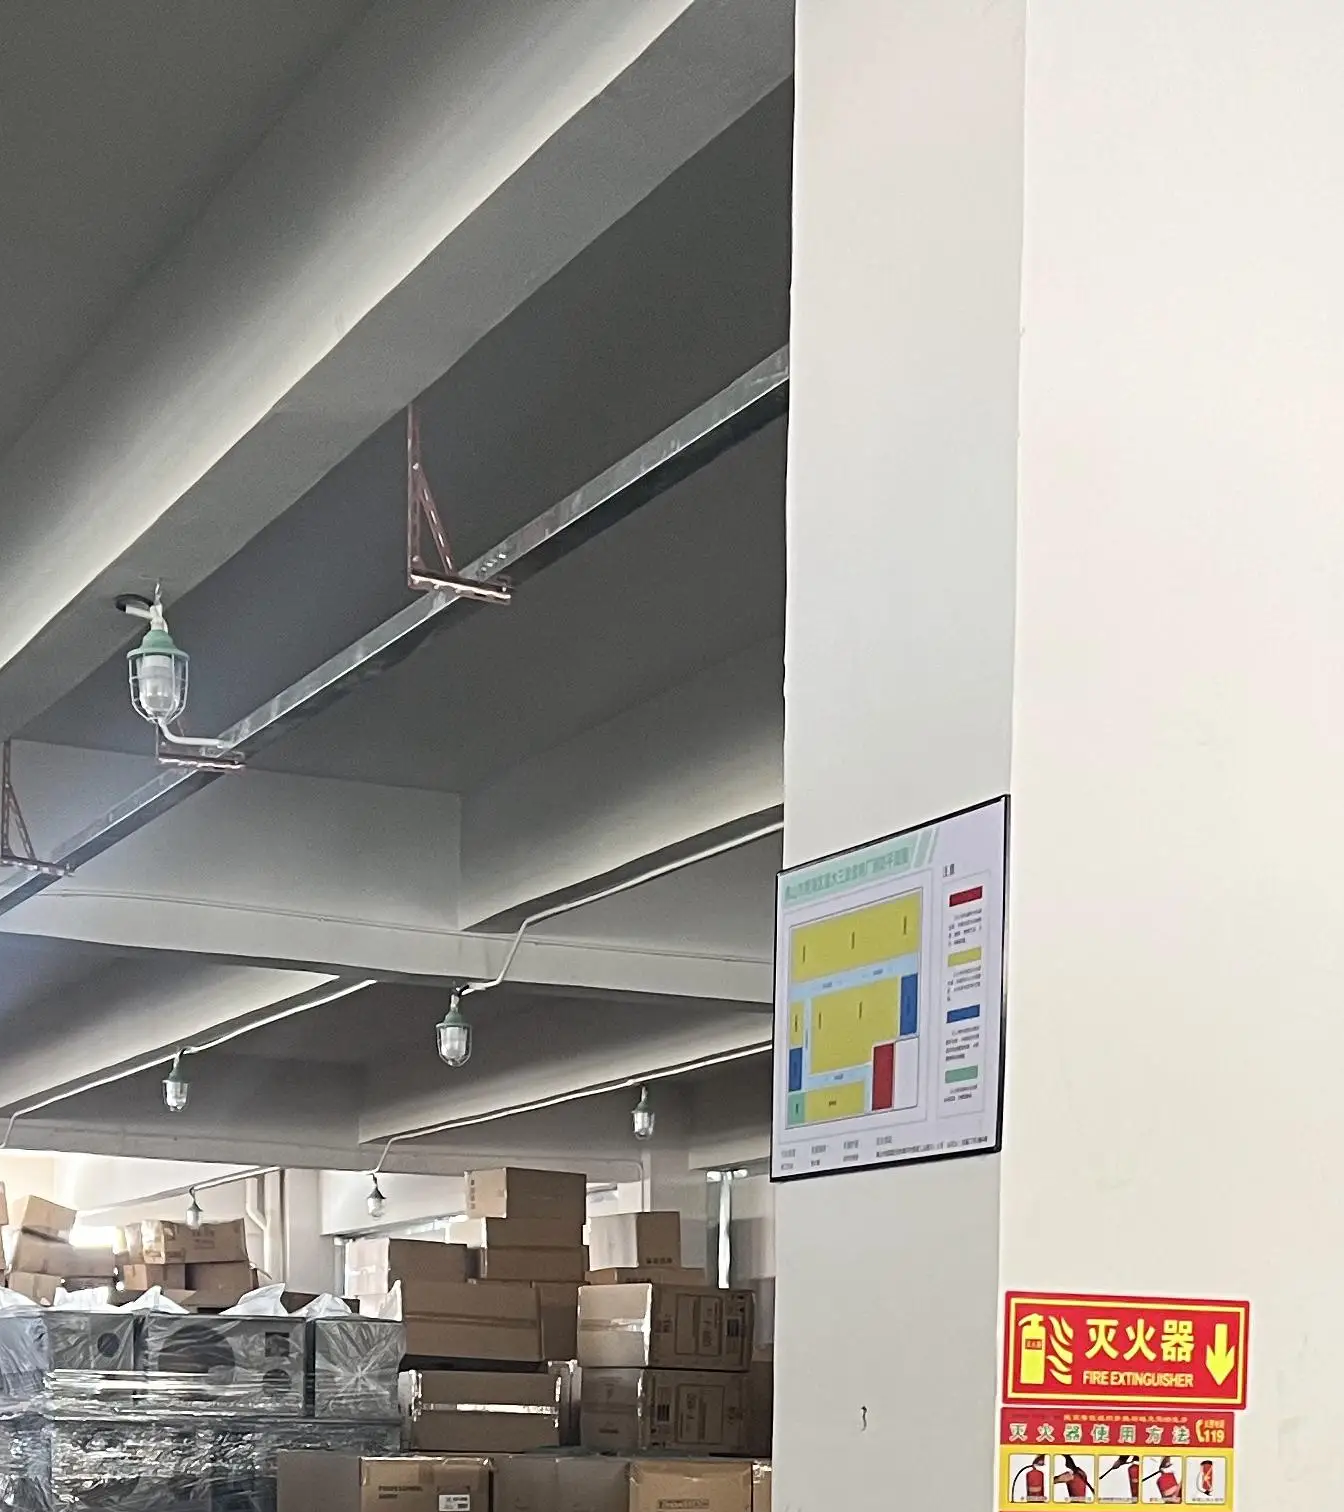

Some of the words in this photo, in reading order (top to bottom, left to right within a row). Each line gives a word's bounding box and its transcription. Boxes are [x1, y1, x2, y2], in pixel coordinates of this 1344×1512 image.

[1085, 1317, 1195, 1363] 灭火器
[1083, 1371, 1108, 1386] FIRE
[1111, 1373, 1194, 1388] EXTINGUISHER
[1008, 1423, 1191, 1445] 灭火器使用方法
[1203, 1428, 1225, 1444] 119
